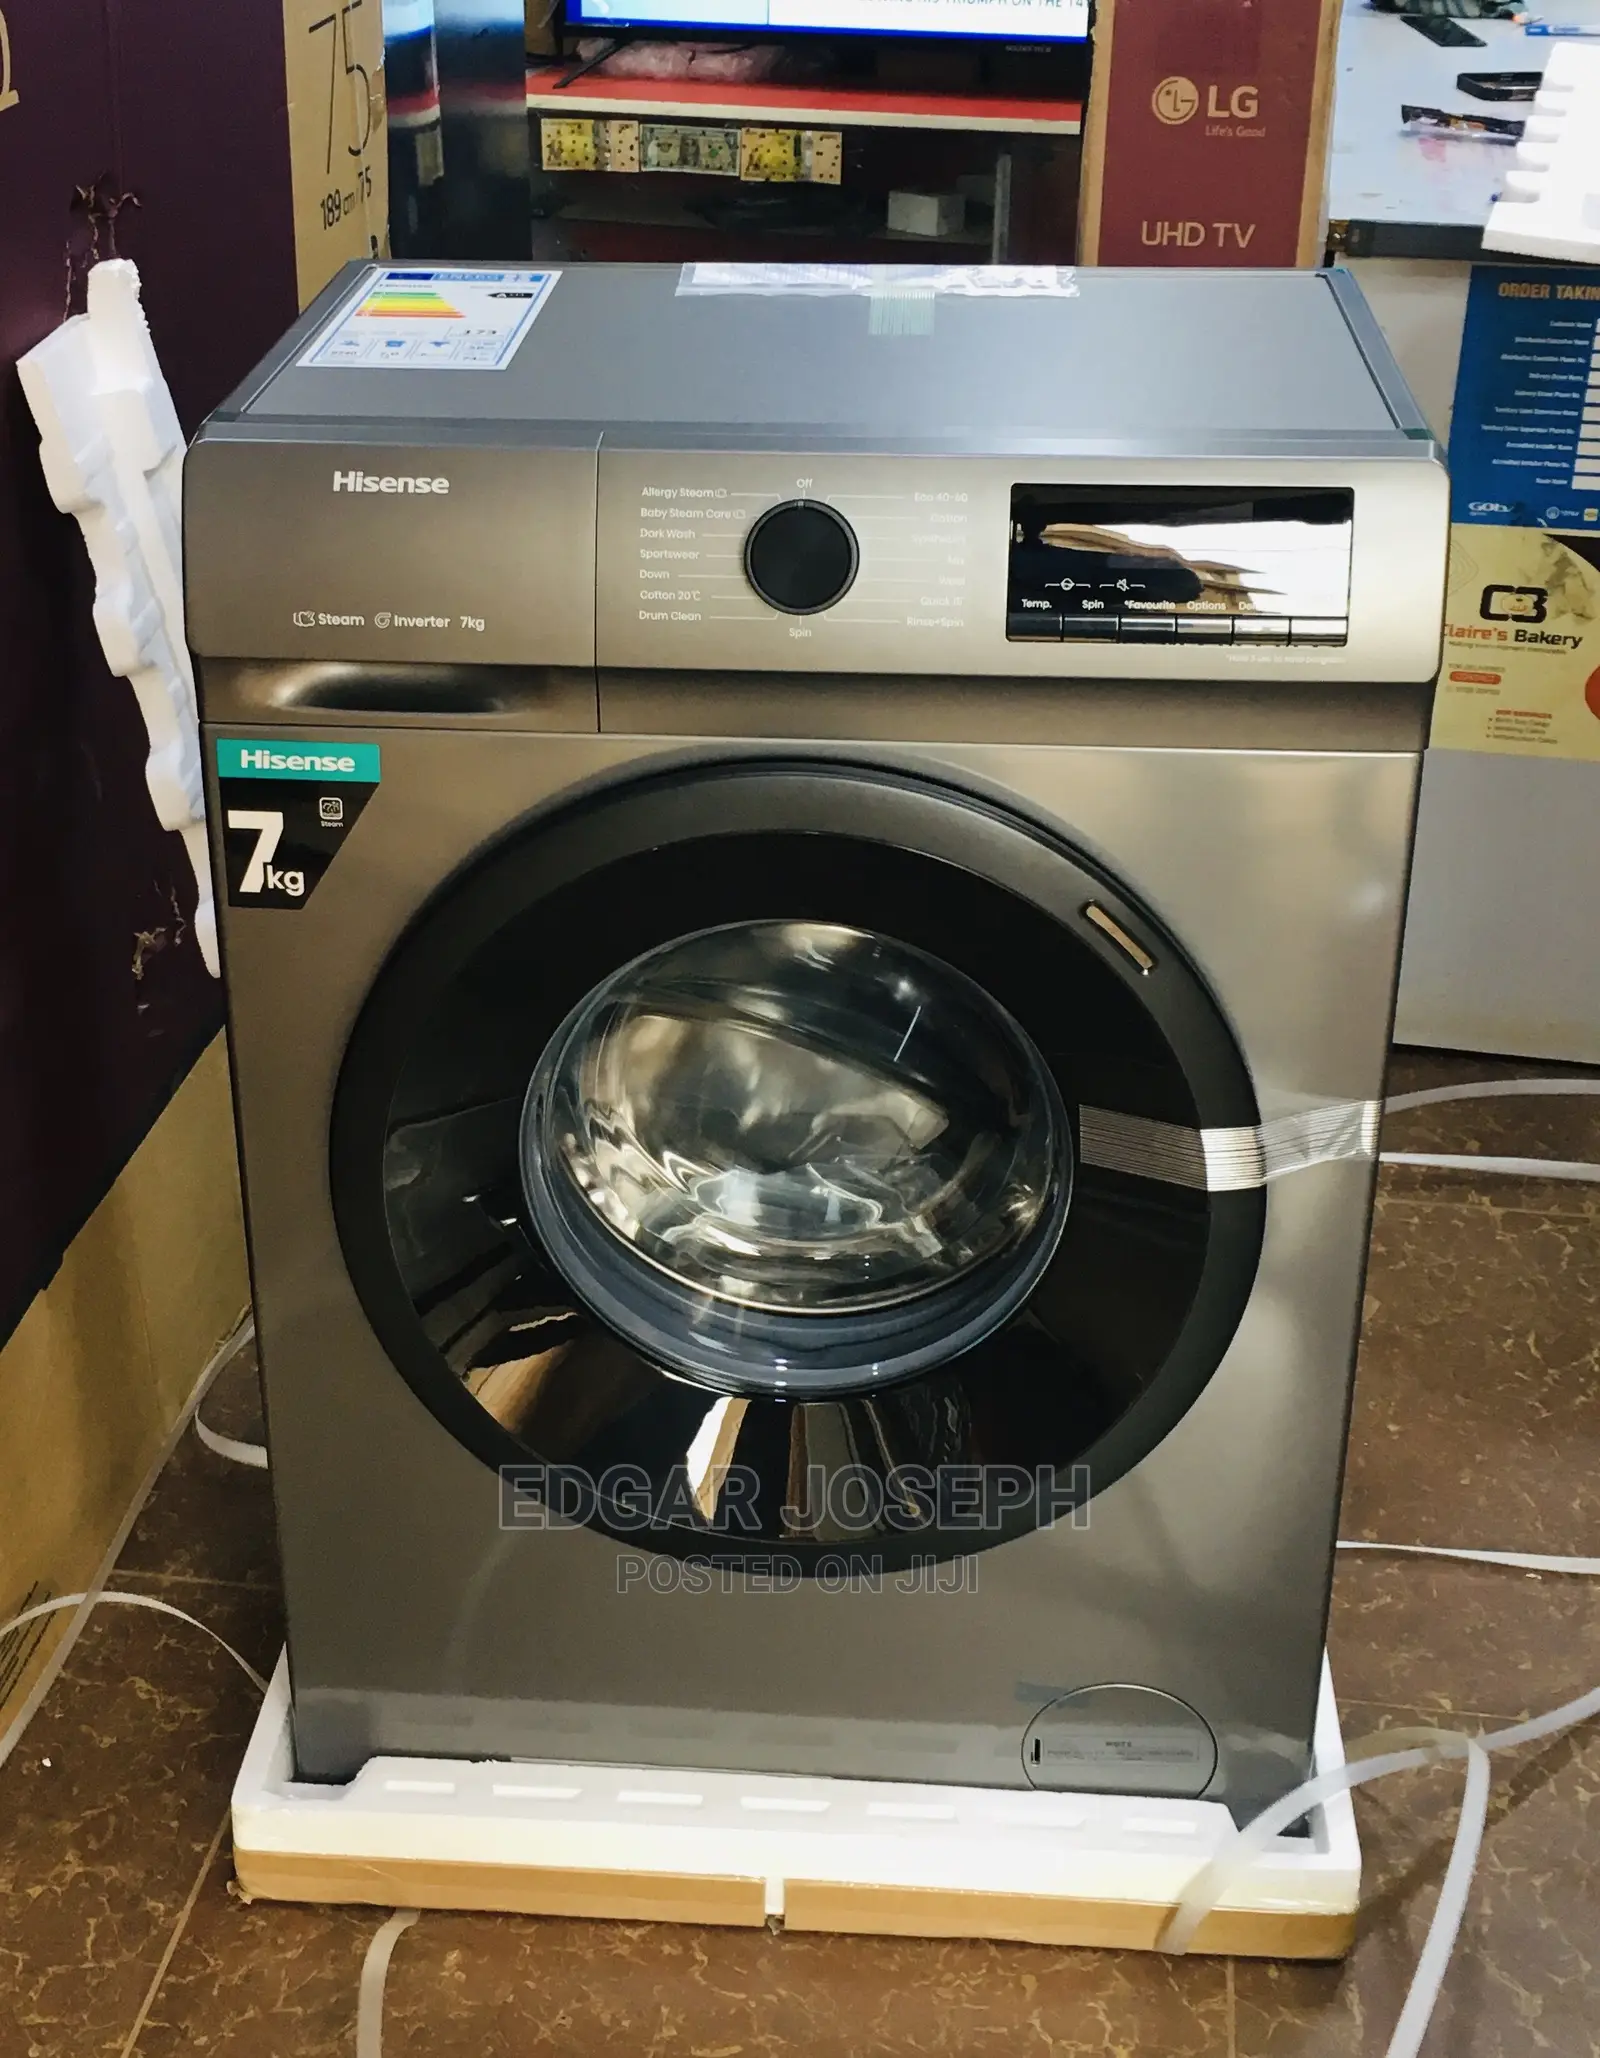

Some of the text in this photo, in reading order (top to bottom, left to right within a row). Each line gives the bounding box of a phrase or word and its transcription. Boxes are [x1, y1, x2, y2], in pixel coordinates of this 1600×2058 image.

[309, 0, 371, 174] 75
[1207, 84, 1259, 119] LG
[1205, 125, 1266, 138] Life's Good
[321, 188, 342, 231] 189
[357, 165, 372, 204] 75
[1141, 220, 1256, 249] UHD TV
[1498, 281, 1550, 299] ORDER
[332, 470, 450, 494] Hisense
[796, 478, 813, 489] Off
[641, 486, 714, 500] Allergy Steam
[914, 491, 933, 502] Eco
[640, 507, 731, 519] Baby Steam Care
[640, 527, 695, 539] Dark Wash
[640, 548, 700, 561] Sportswear
[639, 568, 670, 580] Down
[640, 589, 676, 601] Cotton
[1021, 598, 1052, 610] Temp.
[1081, 600, 1105, 612] Spin
[1187, 600, 1227, 612] Options
[638, 610, 701, 622] Drum Clean
[318, 613, 486, 632] Steam Inverter 7kg
[789, 627, 812, 639] Spin
[1514, 628, 1584, 650] Bakery
[240, 749, 356, 773] Hisense
[320, 820, 344, 828] Steam
